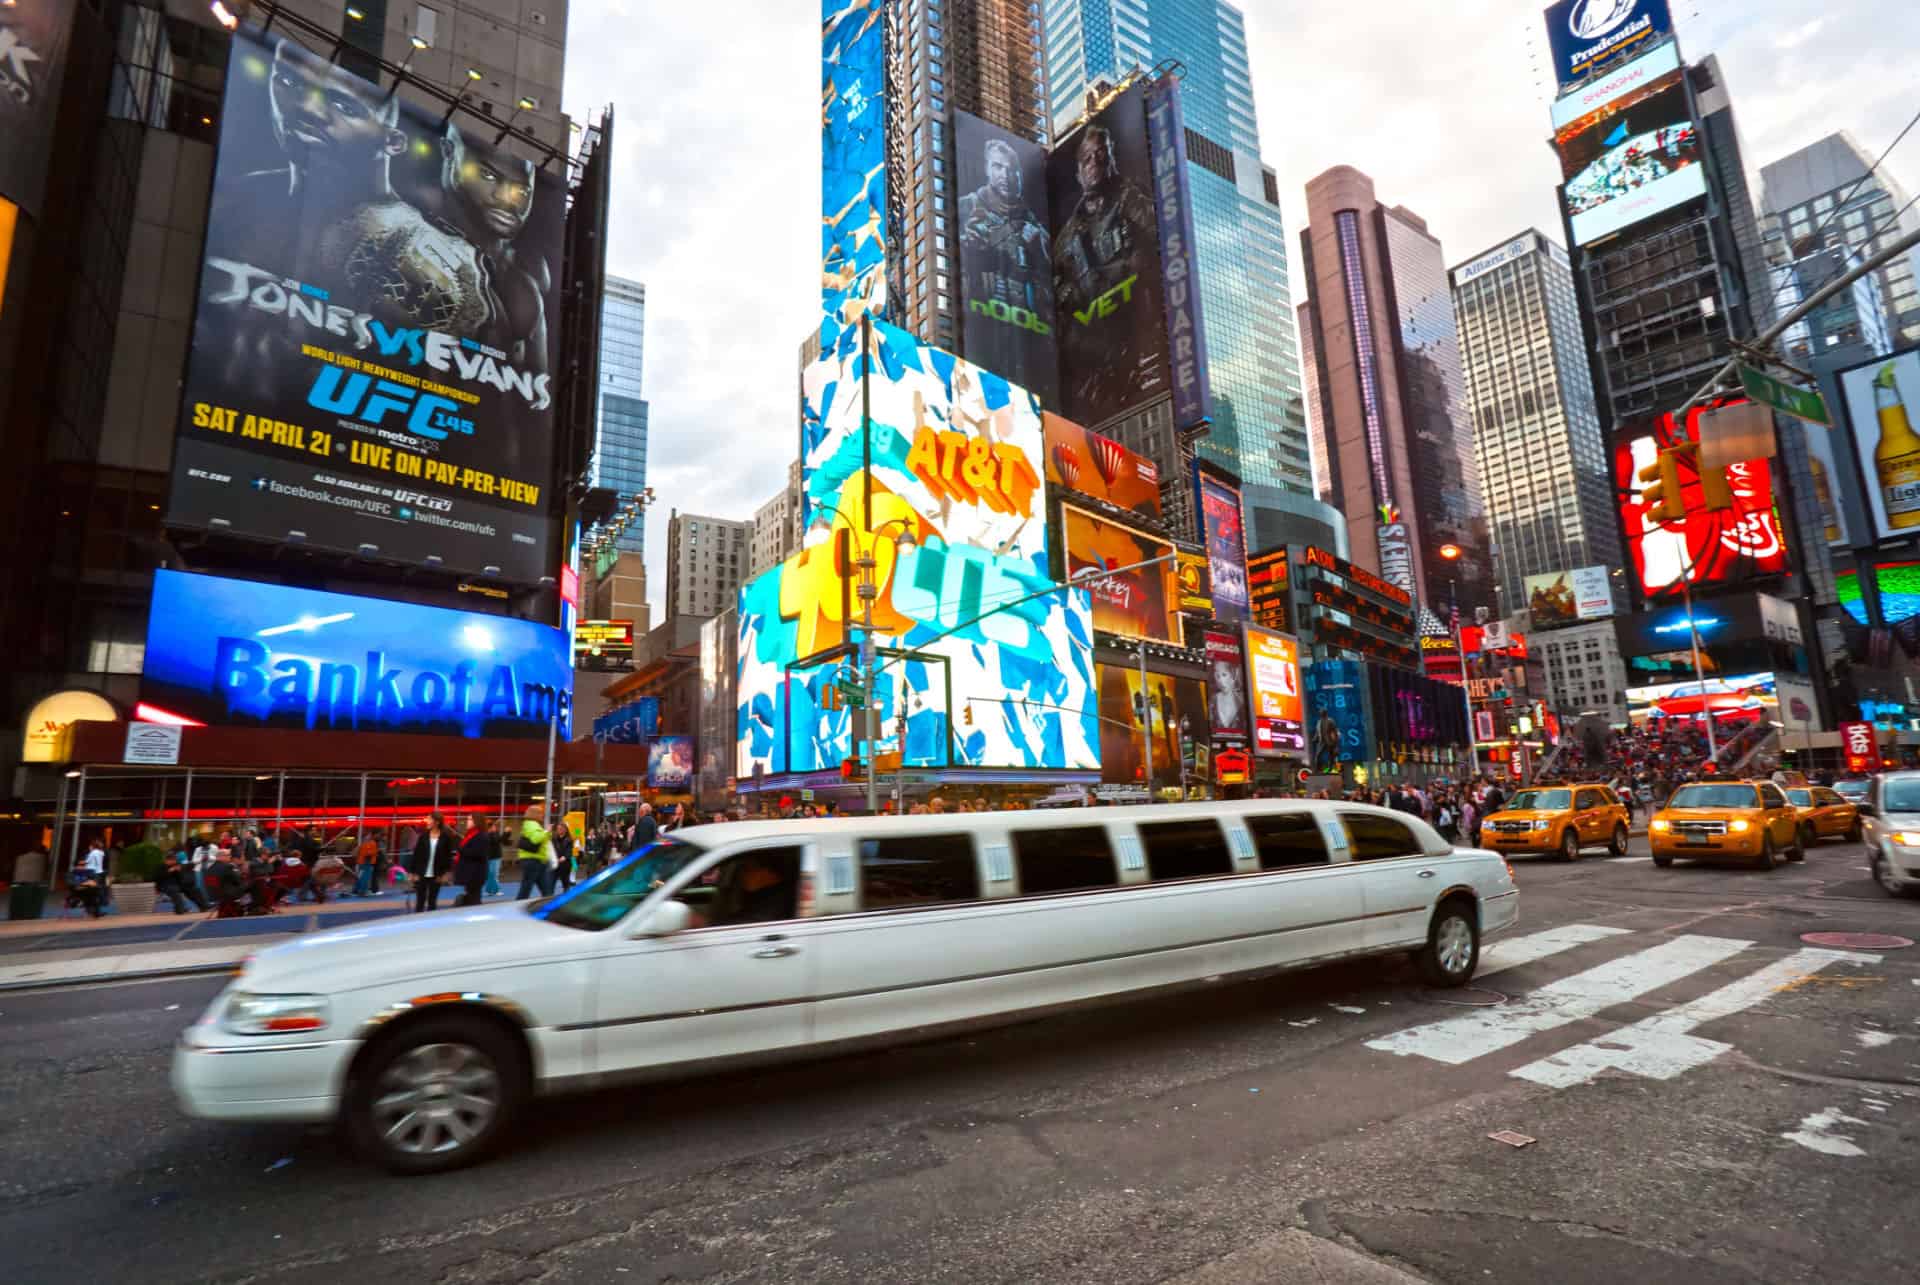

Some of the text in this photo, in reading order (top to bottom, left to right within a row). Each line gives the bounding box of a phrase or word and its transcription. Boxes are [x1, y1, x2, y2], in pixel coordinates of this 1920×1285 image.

[1569, 13, 1651, 66] Prudential
[1148, 102, 1196, 389] TIMES SQUARE
[1464, 252, 1505, 278] Allianz
[1073, 273, 1138, 327] VET
[206, 255, 374, 350] JONES
[425, 329, 552, 411] EVANS
[302, 343, 481, 405] WORLD LIGHT HEAVYWEIGHT CHAMPIONSHIP
[306, 363, 461, 440] UFC
[435, 411, 477, 435] 145
[193, 402, 239, 433] SAT
[240, 414, 306, 450] APRIL
[309, 430, 333, 457] 21
[350, 439, 392, 471] LIVE
[394, 451, 422, 477] ON
[424, 459, 541, 507] PAY-PER-VIEW
[906, 424, 1034, 510] AT&T
[269, 479, 392, 515] facebook.com/UFC
[414, 510, 496, 536] twitter.com/ufc
[213, 636, 404, 716] Bank
[411, 657, 479, 717] of
[1847, 723, 1871, 754] tkts
